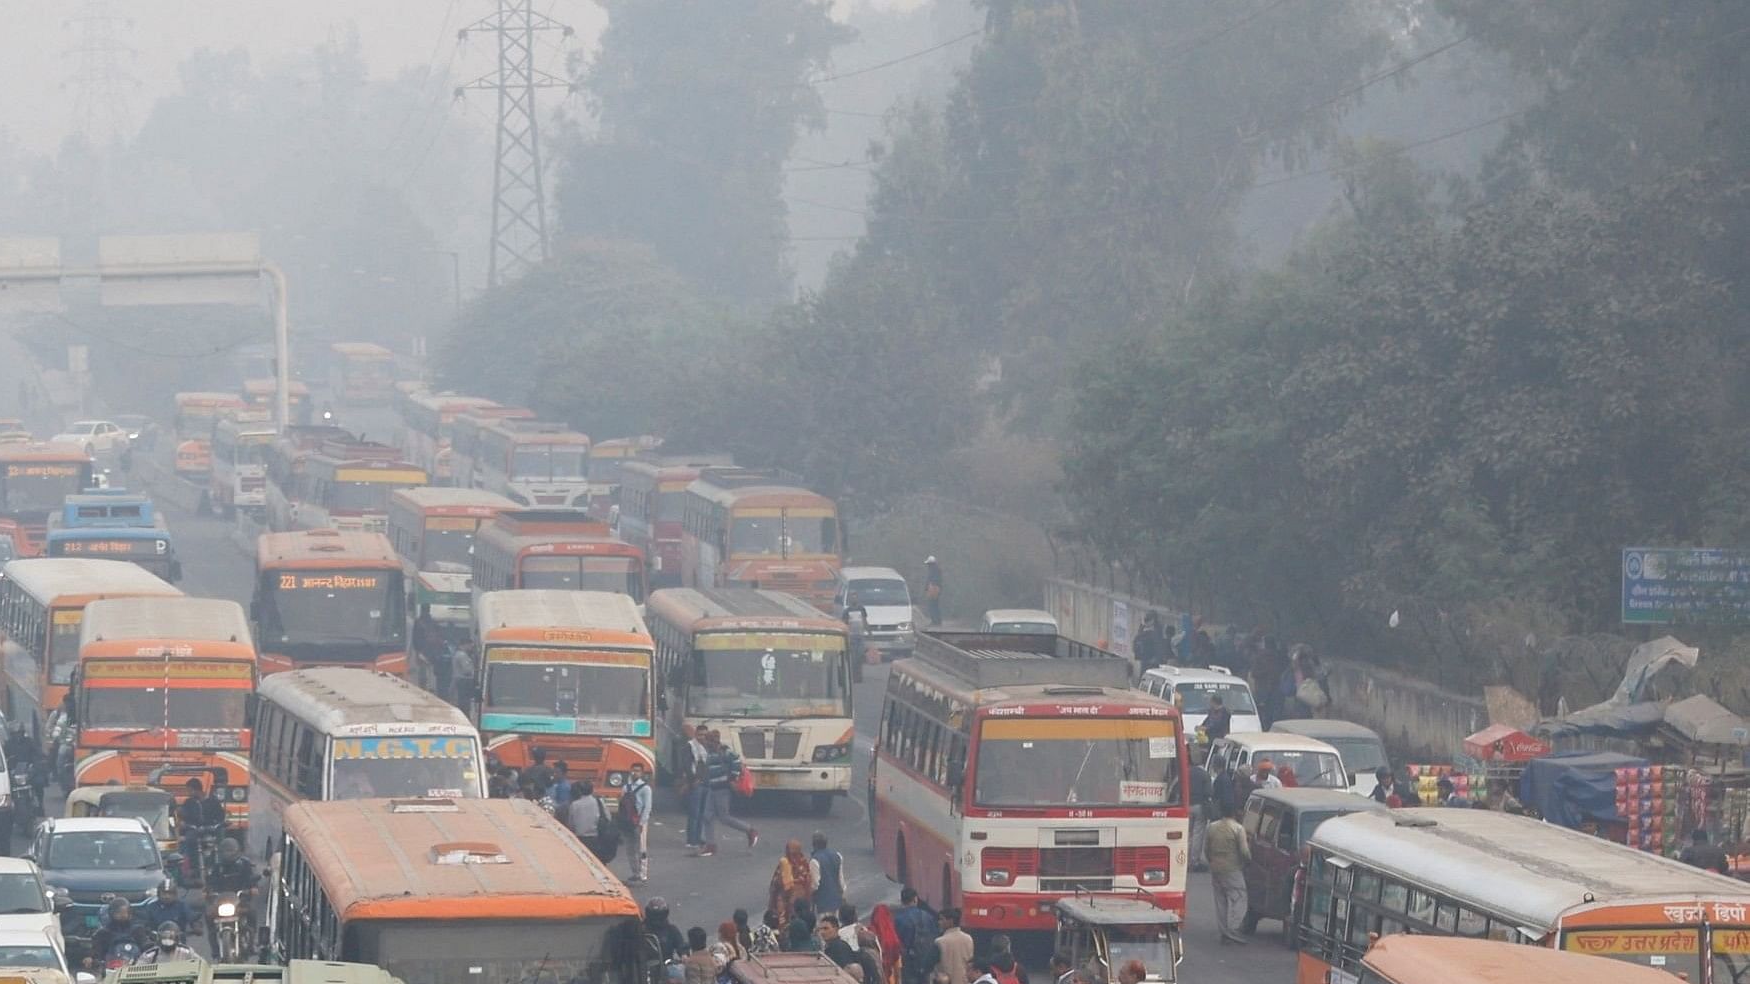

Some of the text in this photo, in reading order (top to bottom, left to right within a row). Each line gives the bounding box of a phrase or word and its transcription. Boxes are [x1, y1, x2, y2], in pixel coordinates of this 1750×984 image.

[280, 576, 296, 589] 221
[1713, 902, 1746, 922] डिपो
[1623, 931, 1750, 951] उत्तर प्रदेश परि
